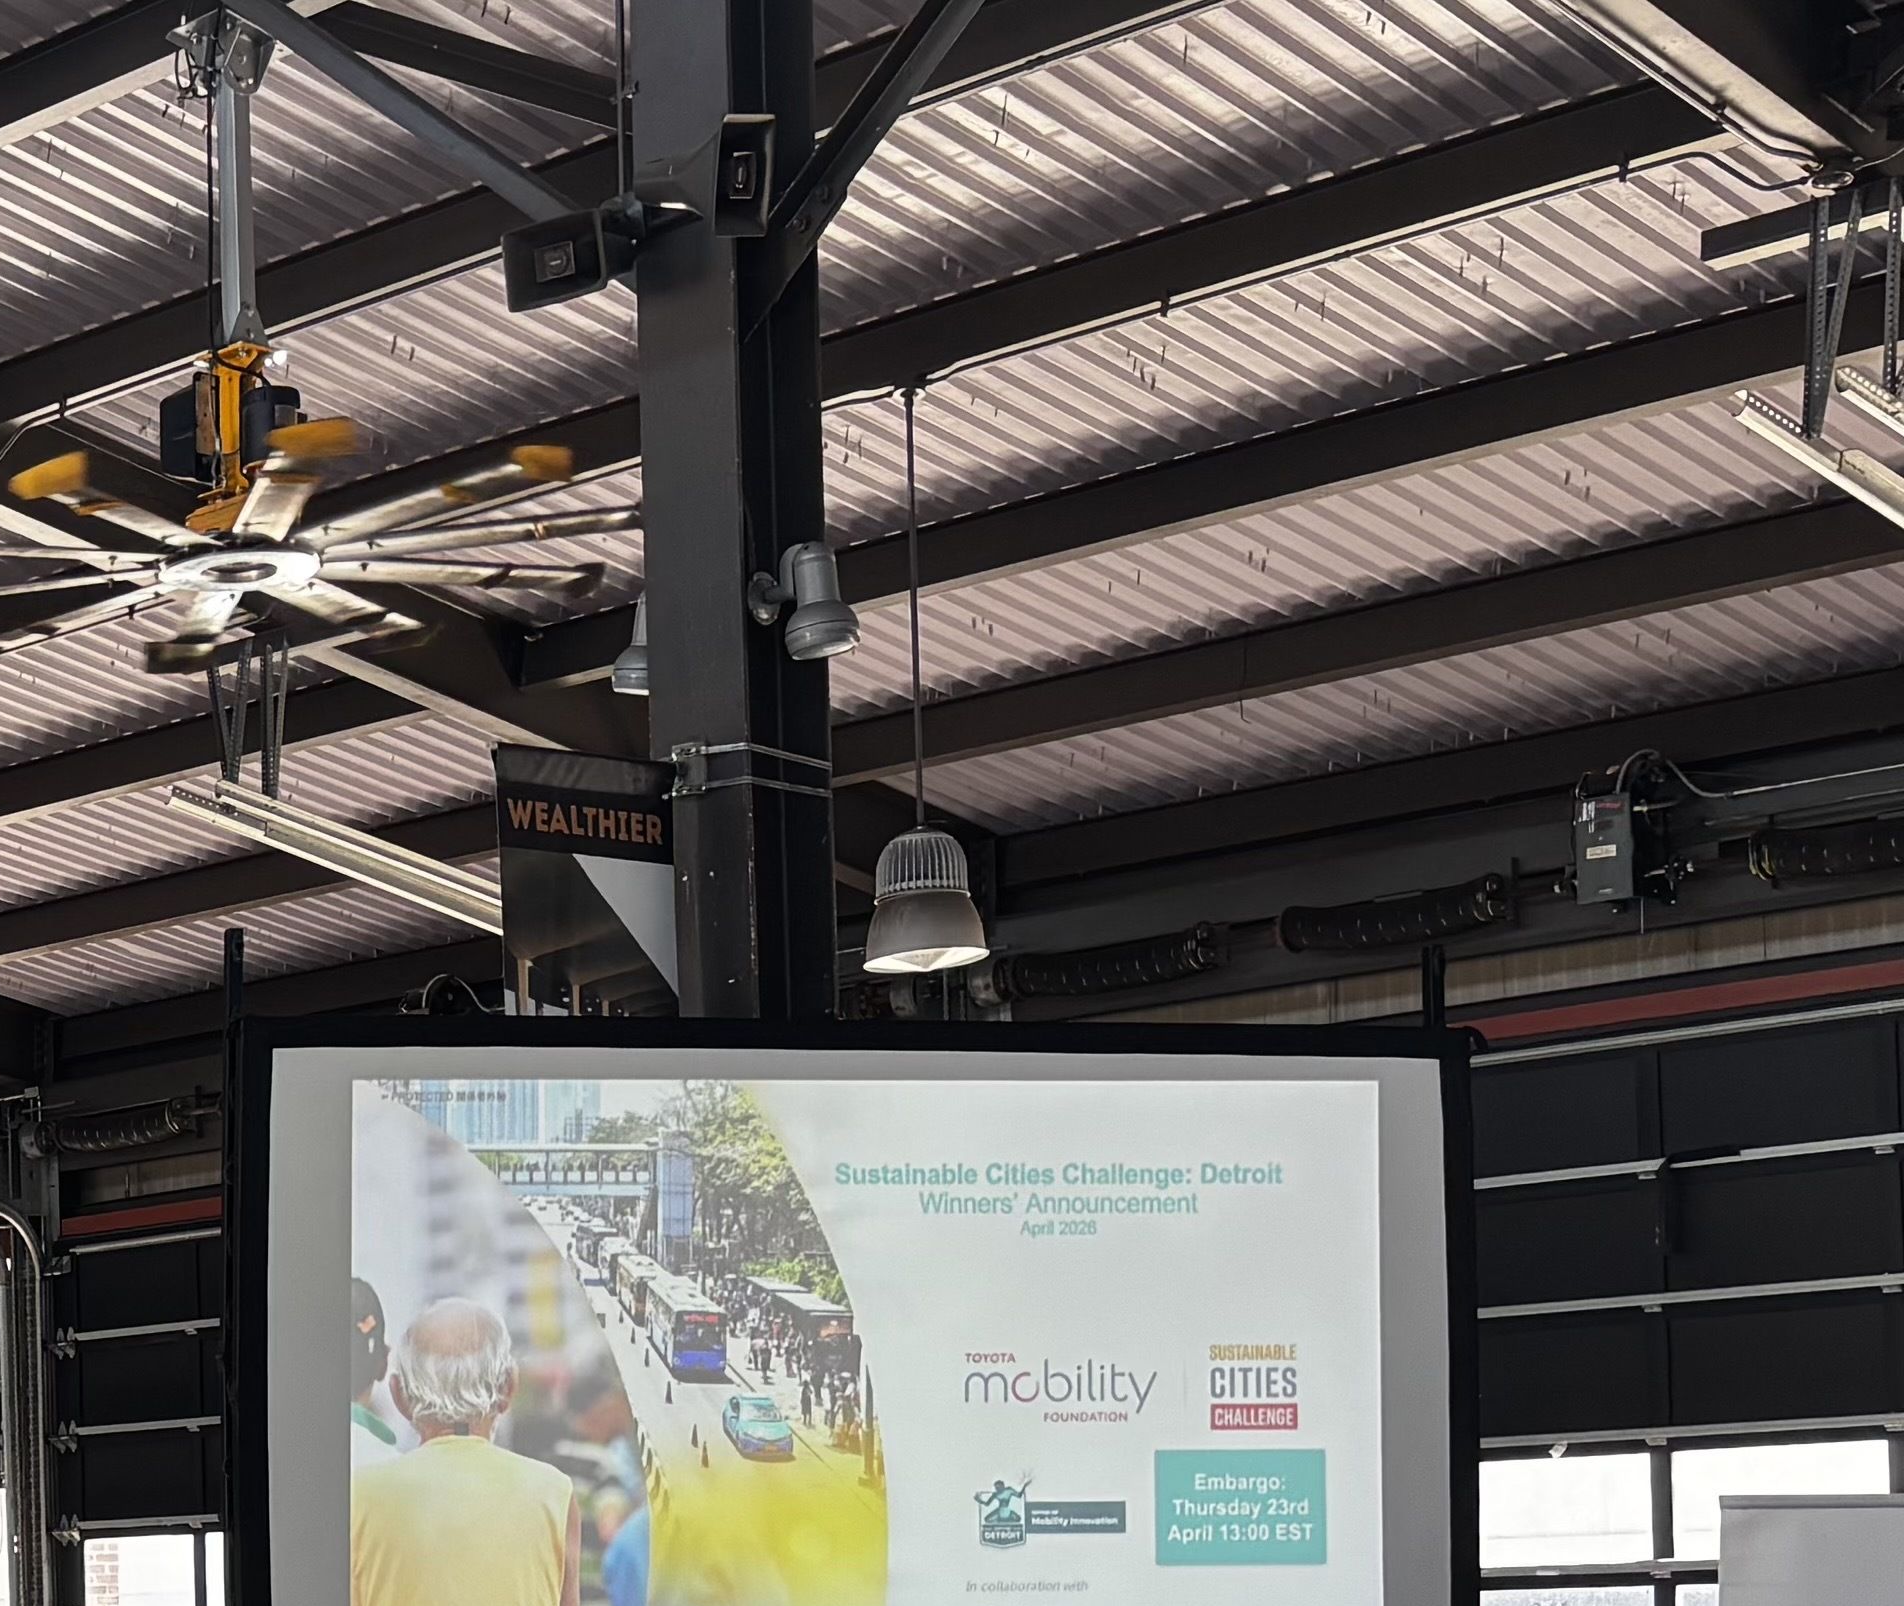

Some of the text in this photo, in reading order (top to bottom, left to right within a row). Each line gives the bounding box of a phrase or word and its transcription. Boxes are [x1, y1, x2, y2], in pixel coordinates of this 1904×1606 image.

[507, 798, 663, 845] WEALTHIER
[834, 1162, 1283, 1190] Sustainable Cities Challenge: Detroit
[1025, 1192, 1198, 1215] Announcement
[1020, 1219, 1097, 1239] April 2026
[965, 1352, 1016, 1364] TOYOTA
[1208, 1344, 1297, 1361] SUSTAINABLE
[964, 1358, 1158, 1414] mobility
[1209, 1366, 1297, 1399] CITIES
[1043, 1411, 1129, 1423] FOUNDATION
[1214, 1407, 1295, 1427] CHALLENGE
[1193, 1472, 1286, 1494] Embargo:
[1172, 1498, 1309, 1519] Thursday 23rd
[1167, 1523, 1313, 1544] April 13:00 EST
[981, 1580, 1061, 1593] collaboration
[1063, 1580, 1089, 1592] with
